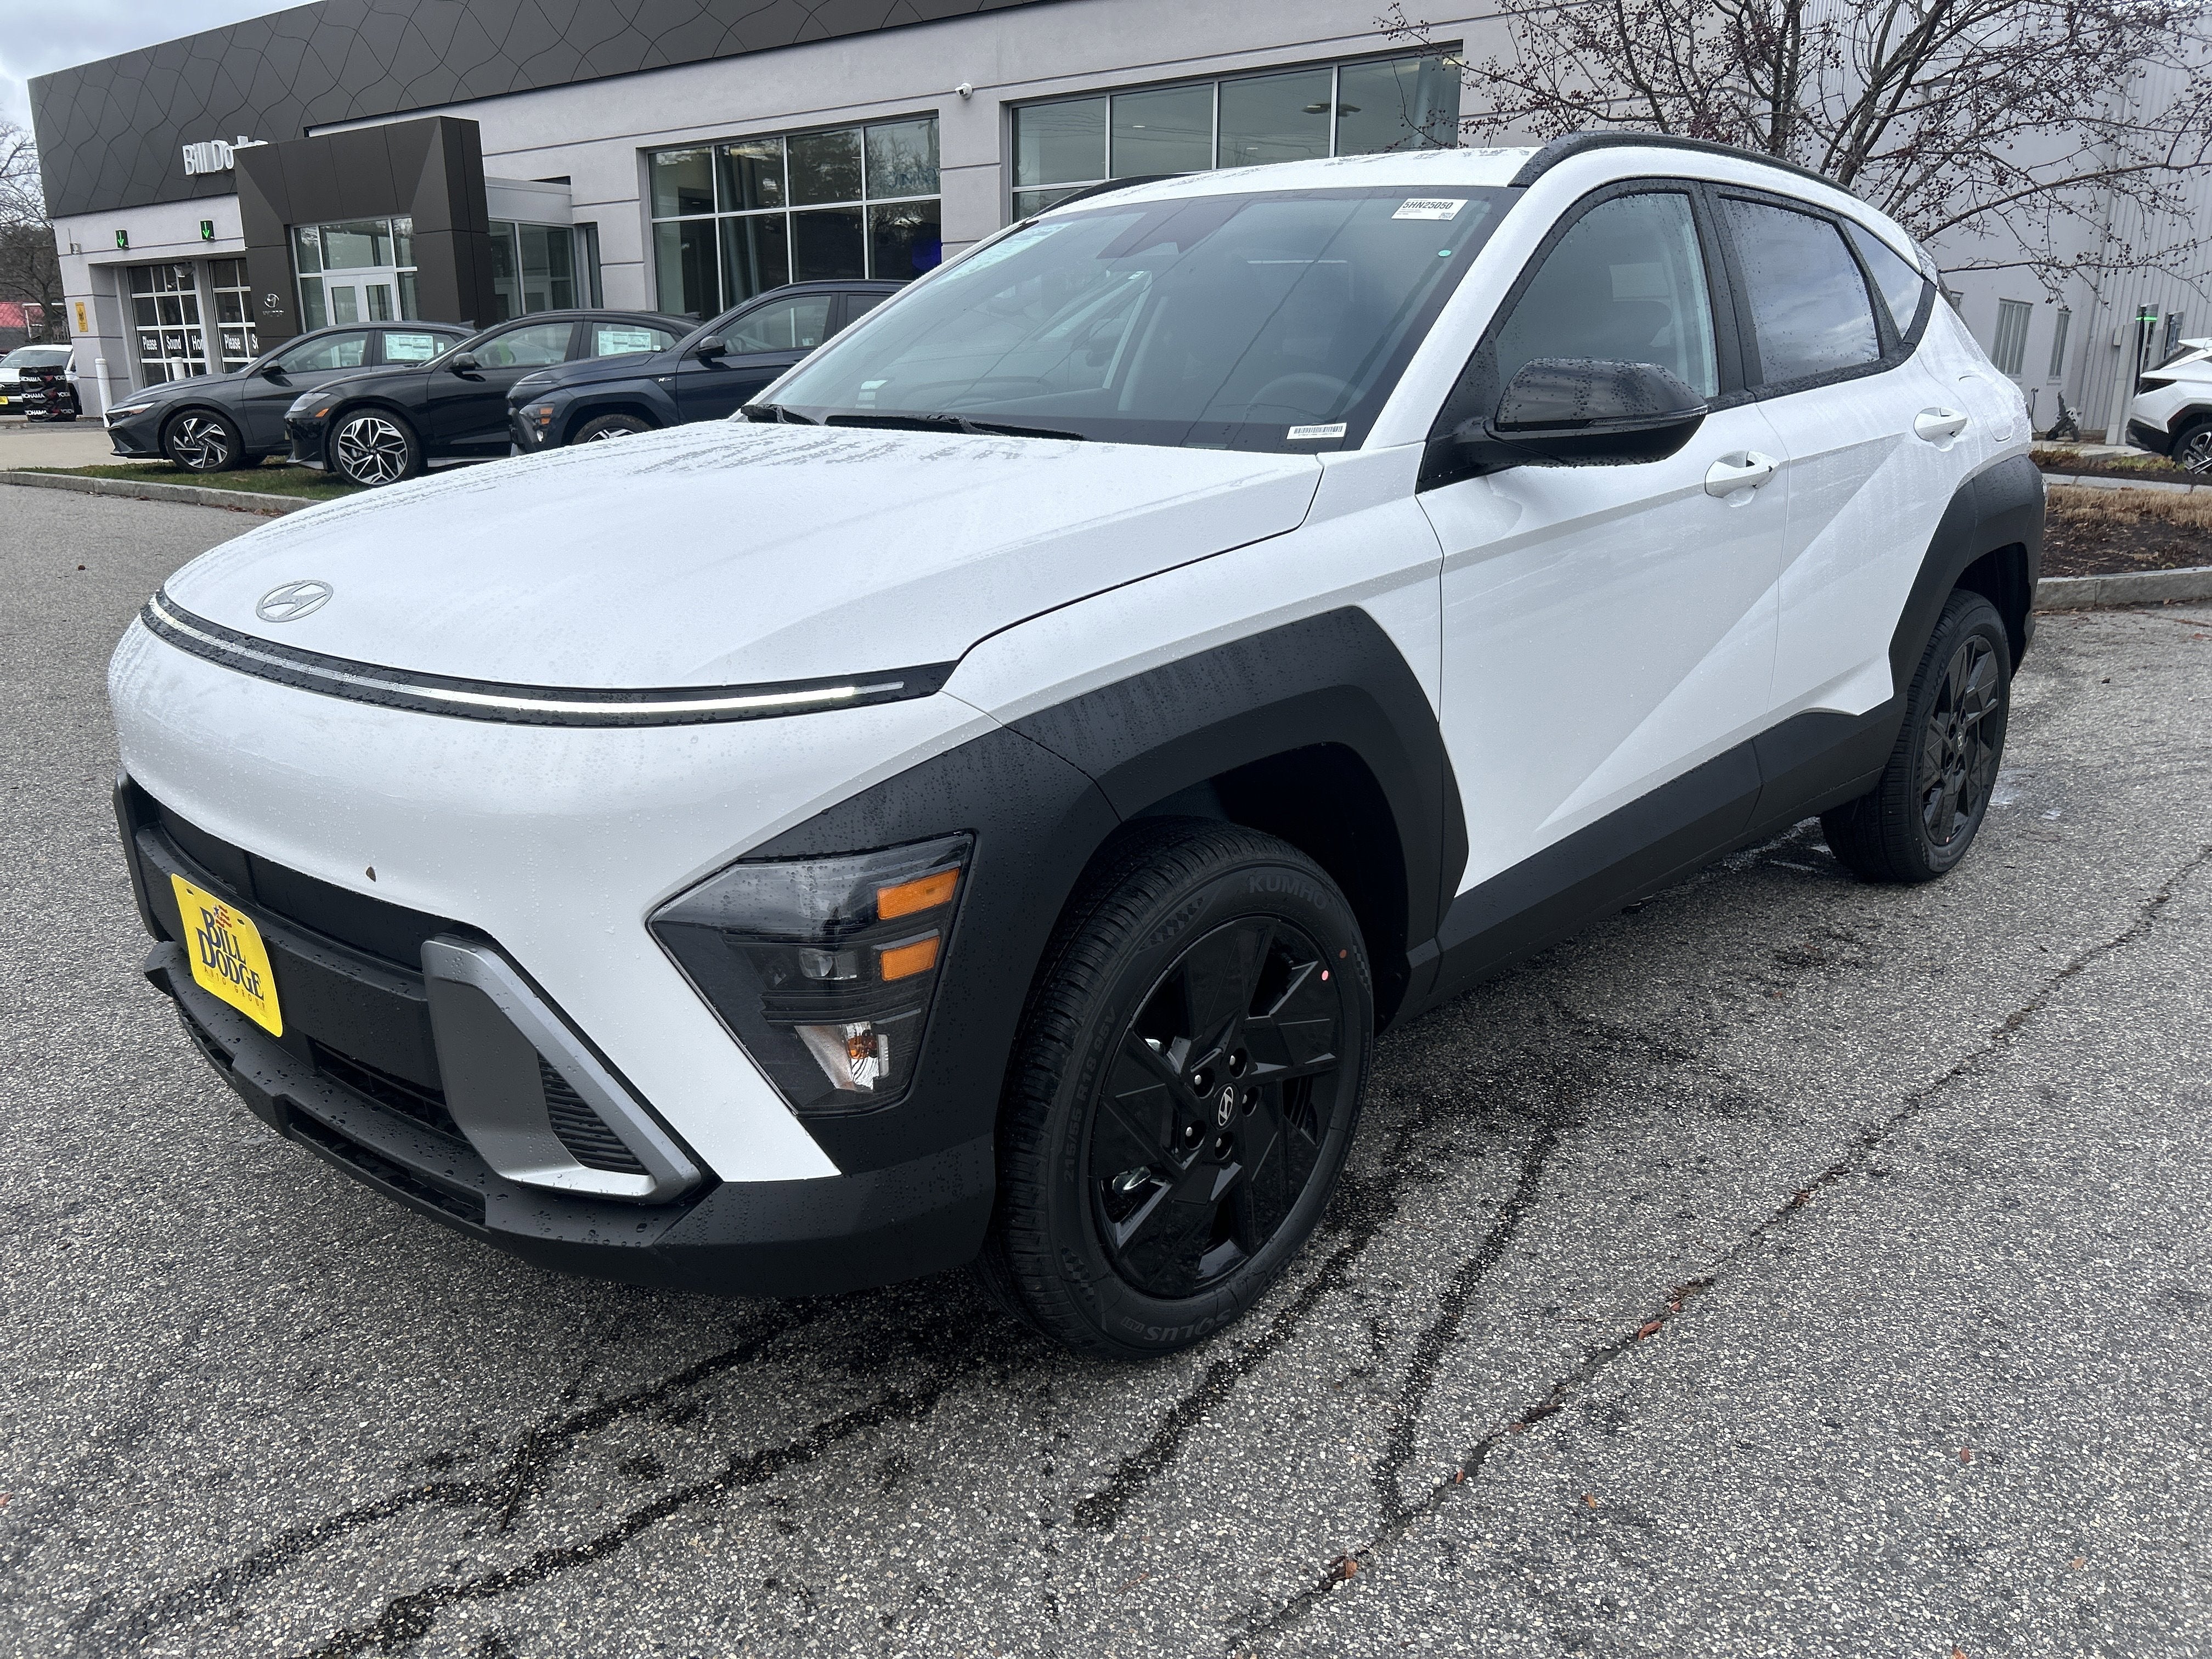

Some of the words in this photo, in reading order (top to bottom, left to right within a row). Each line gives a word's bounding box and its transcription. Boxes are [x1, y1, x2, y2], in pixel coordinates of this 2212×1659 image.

[182, 142, 216, 176] Bill
[142, 336, 157, 351] Please
[166, 335, 182, 350] Sound
[223, 334, 241, 350] Please
[1250, 874, 1328, 911] KUMHO
[200, 906, 246, 965] BILL
[195, 927, 264, 1001] DODGE
[205, 966, 226, 985] AUTO
[234, 985, 265, 1011] GROUP
[1063, 1107, 1083, 1183] 215/55
[1076, 1056, 1097, 1101] R18
[1093, 1005, 1116, 1053] 95V
[1143, 1308, 1231, 1342] SOLUS
